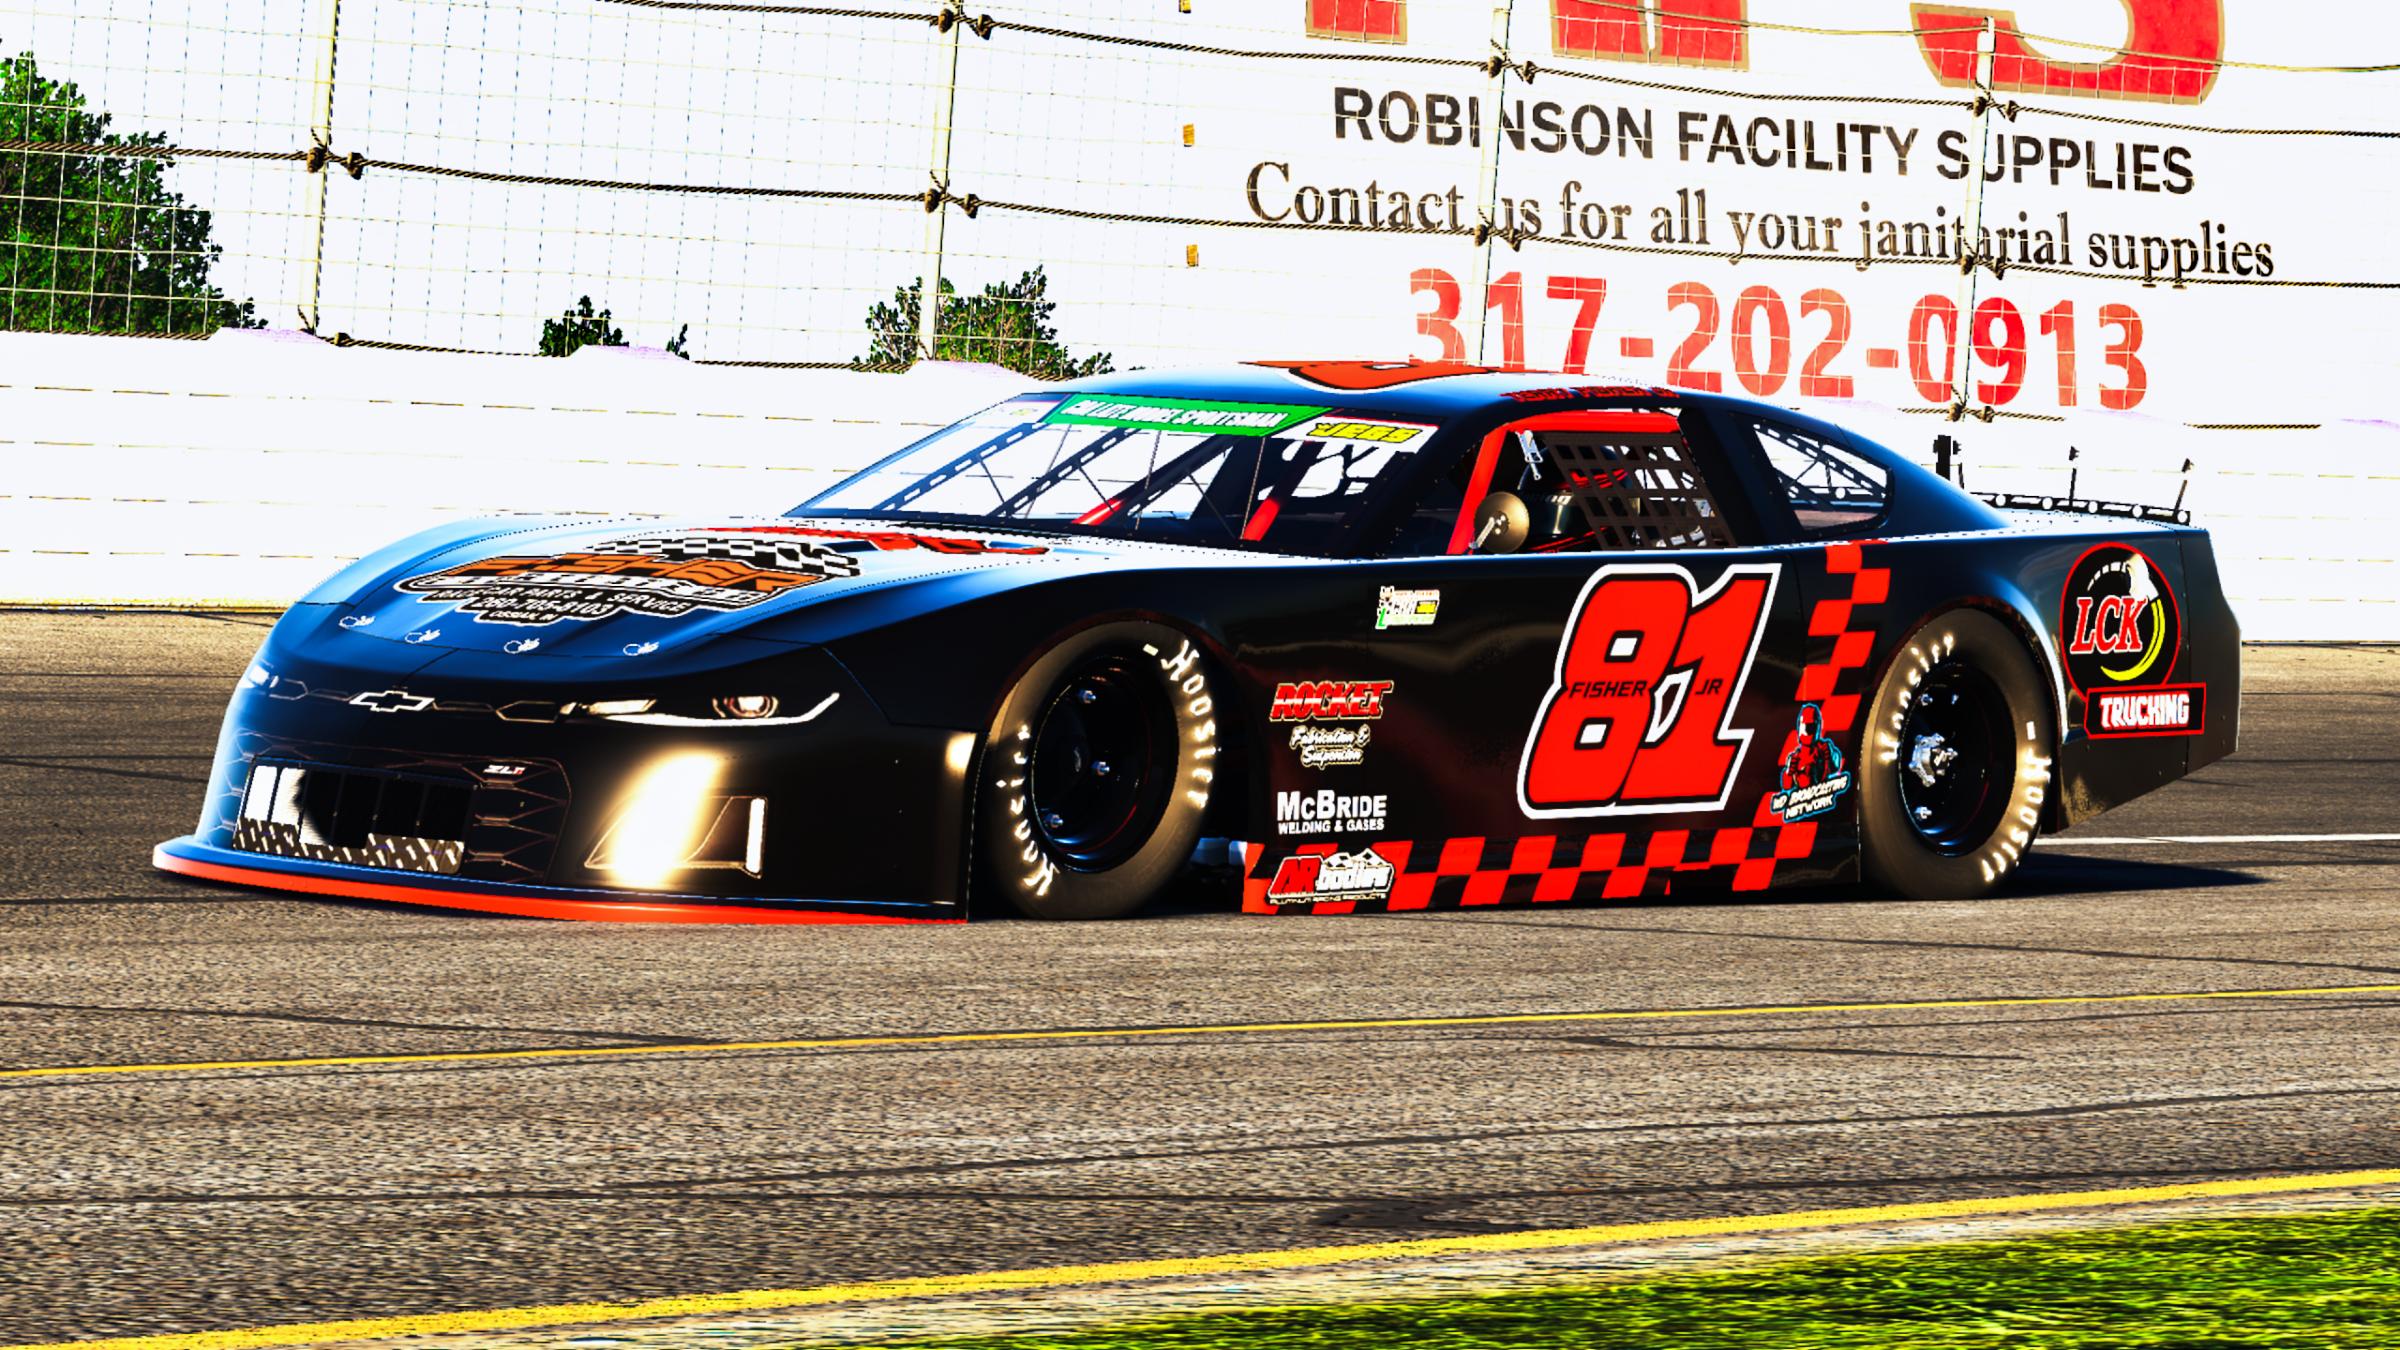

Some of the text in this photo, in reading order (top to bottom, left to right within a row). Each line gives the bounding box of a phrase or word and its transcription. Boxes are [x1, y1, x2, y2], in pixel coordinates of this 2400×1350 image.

[1334, 86, 2195, 194] ROBINSON FACILITY SUPPLIES
[1247, 162, 1464, 231] Contact
[1560, 180, 1632, 241] for
[1650, 187, 1710, 245] all
[1727, 208, 1842, 265] your
[2089, 220, 2274, 288] supplies
[1409, 268, 2147, 410] 317-202-0913
[520, 587, 582, 600] PARTS
[611, 592, 691, 613] SERVICE
[2069, 594, 2148, 655] LCK
[1269, 681, 1394, 721] ROCKET
[1518, 564, 1781, 818] 81
[1569, 678, 1723, 698] FISHER JR
[2098, 692, 2190, 728] TRUCKING
[1278, 819, 1384, 834] WELDING & GASES
[1785, 794, 1834, 819] NETWORK
